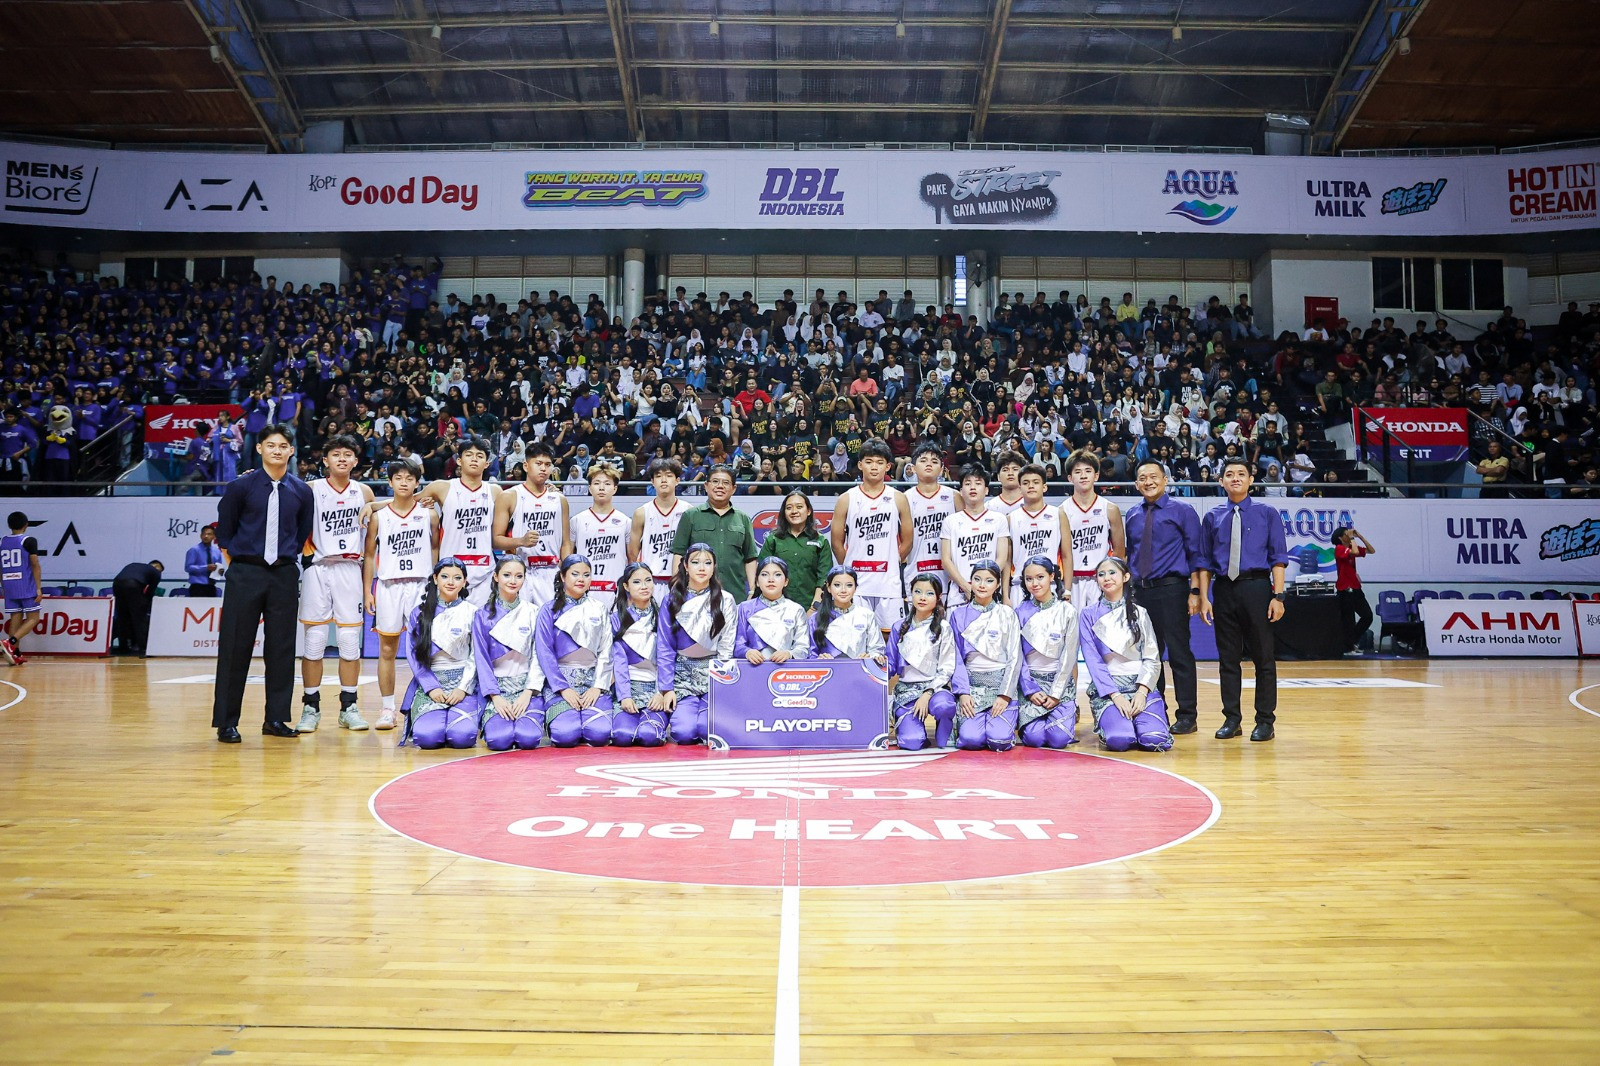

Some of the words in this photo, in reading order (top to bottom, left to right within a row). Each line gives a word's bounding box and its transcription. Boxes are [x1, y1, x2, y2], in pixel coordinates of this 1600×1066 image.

[643, 173, 661, 184] YA
[758, 168, 844, 202] DBL
[950, 170, 1062, 200] STREET
[1162, 169, 1239, 200] AQUA
[1508, 166, 1564, 192] HOT
[6, 176, 82, 202] Bioré
[340, 176, 415, 205] Good
[422, 176, 478, 211] Day
[926, 184, 948, 196] PAKE
[1306, 180, 1372, 198] ULTRA
[758, 203, 844, 216] INDONESIA
[953, 204, 976, 217] GAYA
[978, 200, 1008, 214] MAKIN
[1314, 200, 1366, 217] MILK
[1510, 190, 1597, 216] CREAM
[1386, 422, 1464, 432] HONDA
[322, 507, 360, 522] NATION
[454, 507, 488, 520] NATION
[523, 511, 556, 523] NATION
[855, 512, 891, 528] NATION
[914, 512, 949, 528] NATION
[325, 518, 352, 532] STAR
[457, 517, 482, 530] STAR
[859, 523, 882, 538] STAR
[918, 522, 942, 537] STAR
[1447, 518, 1527, 539] ULTRA
[388, 529, 424, 545] NATION
[649, 530, 675, 544] NATIO
[1020, 530, 1052, 545] NATION
[1070, 525, 1104, 539] NATION
[339, 540, 346, 550] 6
[392, 540, 416, 554] STAR
[466, 537, 476, 549] 91
[585, 536, 619, 548] NATION
[958, 532, 994, 548] NATION
[1073, 536, 1096, 550] STAR
[587, 545, 611, 557] STAR
[867, 544, 874, 556] 8
[927, 543, 938, 554] 14
[961, 543, 987, 557] STAR
[1457, 543, 1521, 564] MILK
[1, 549, 21, 568] 20
[399, 560, 413, 570] 89
[662, 559, 668, 570] 7
[594, 564, 605, 575] 17
[51, 612, 98, 642] Day
[1442, 612, 1560, 630] AHM
[1442, 635, 1453, 643] PT
[1458, 634, 1486, 644] Astra
[1489, 634, 1525, 644] Honda
[1528, 634, 1561, 644] Motor
[746, 719, 852, 732] PLAYOFFS
[546, 785, 1035, 800] HONDA
[506, 816, 705, 839] One
[728, 819, 1079, 840] HEART.
